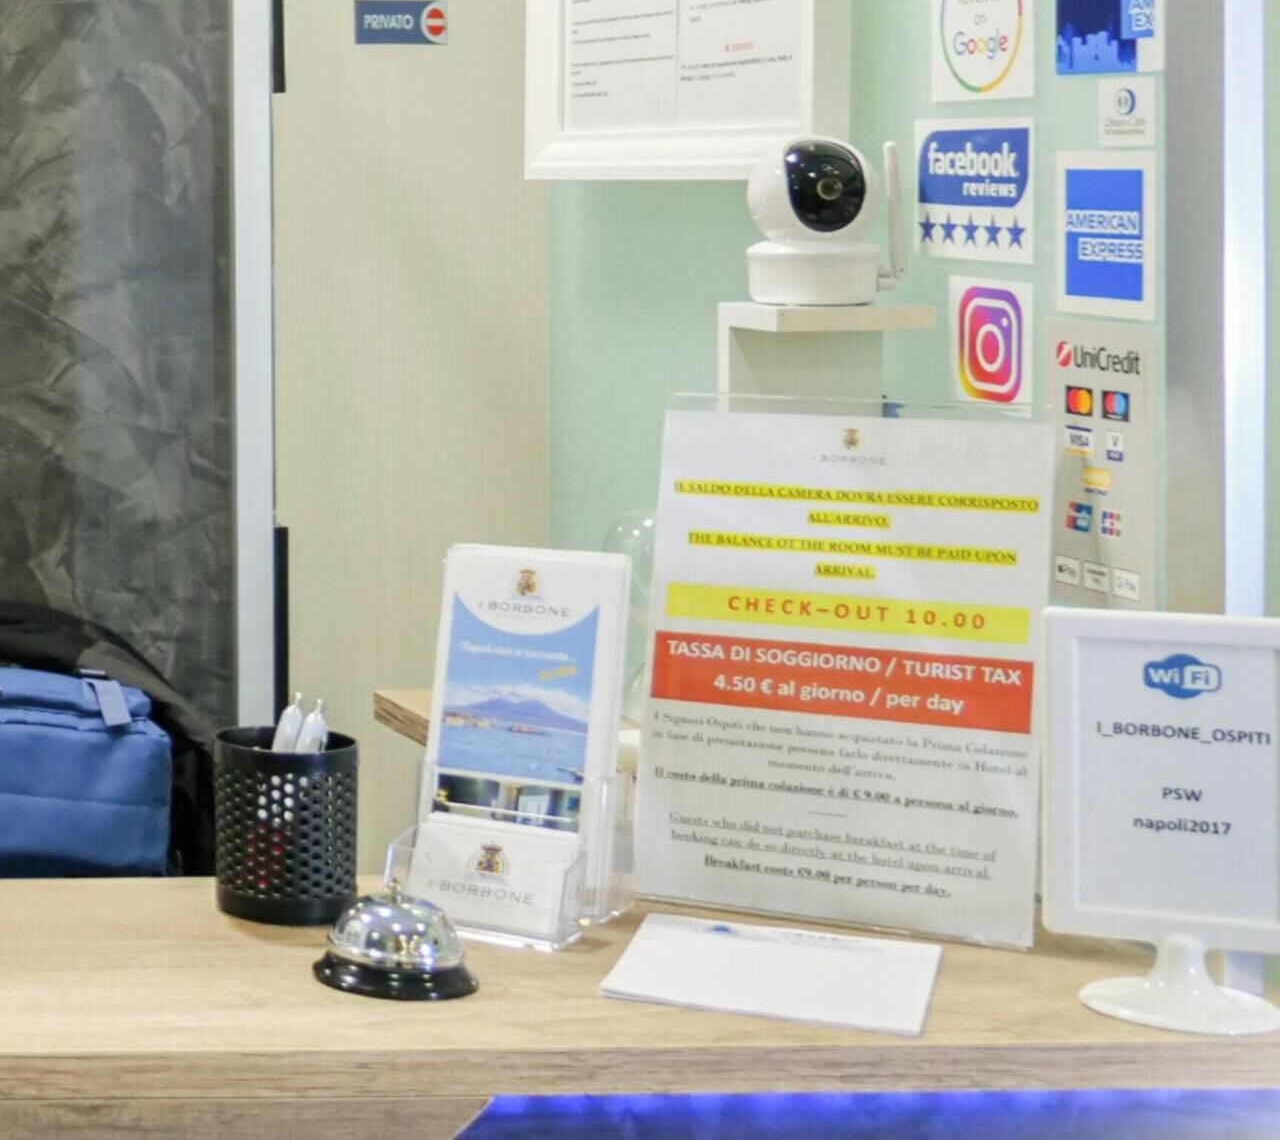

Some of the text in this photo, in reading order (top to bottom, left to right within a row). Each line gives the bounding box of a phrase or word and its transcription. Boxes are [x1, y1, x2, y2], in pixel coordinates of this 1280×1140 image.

[363, 14, 414, 30] PRIVATO
[953, 27, 1008, 60] Google
[963, 179, 1017, 198] reviews
[1066, 212, 1139, 234] AMERICAN
[1080, 238, 1143, 260] EXPRESS
[1073, 344, 1142, 375] UniCredit
[690, 482, 731, 495] SALDO
[734, 484, 775, 497] DELLA
[778, 487, 833, 500] CAMERA
[888, 492, 933, 506] ESSERE
[938, 495, 1039, 511] CORRISPOSTO
[689, 532, 715, 545] THE
[718, 534, 775, 549] BALANCE
[801, 539, 827, 551] THE
[830, 541, 874, 554] ROOM
[876, 544, 914, 557] MUST
[918, 546, 932, 558] BE
[939, 547, 971, 561] PAID
[976, 550, 1017, 563] UPON
[815, 563, 876, 579] ARRIVAL.
[488, 600, 571, 618] BORBONE
[906, 609, 985, 629] 10.00
[667, 640, 1022, 685] TASSA DI SOGGIORNO TURIST TAX
[713, 675, 965, 715] 4.50 € al giorno per day
[662, 713, 703, 726] Signori
[707, 717, 743, 732] Ospiti
[746, 720, 767, 732] che
[769, 725, 793, 735] non
[796, 726, 834, 740] hanno
[923, 738, 961, 752] Prima
[966, 742, 1028, 758] Colazione
[1097, 721, 1271, 745] I_BORBONE_OSPITI
[692, 731, 704, 743] di
[707, 734, 784, 751] prenotazione
[975, 760, 1012, 774] Hotel
[1015, 765, 1027, 777] al
[768, 759, 825, 772] momento
[667, 770, 696, 782] costo
[699, 771, 727, 786] della
[730, 777, 765, 790] prima
[768, 780, 824, 796] colazione
[905, 796, 953, 811] persona
[1162, 786, 1203, 802] PSW
[712, 817, 737, 830] who
[740, 820, 760, 833] did
[786, 828, 841, 843] purchase
[845, 833, 905, 850] breakfast
[925, 843, 945, 855] the
[950, 847, 980, 860] time
[1133, 816, 1232, 836] napoli2017
[671, 829, 718, 846] booking
[871, 854, 904, 868] hotel
[908, 861, 940, 873] upon
[704, 854, 762, 872] Breakfast
[764, 864, 794, 877] costs
[833, 873, 853, 885] per
[856, 876, 897, 890] person
[901, 882, 921, 894] per
[440, 880, 534, 906] BORBONE
